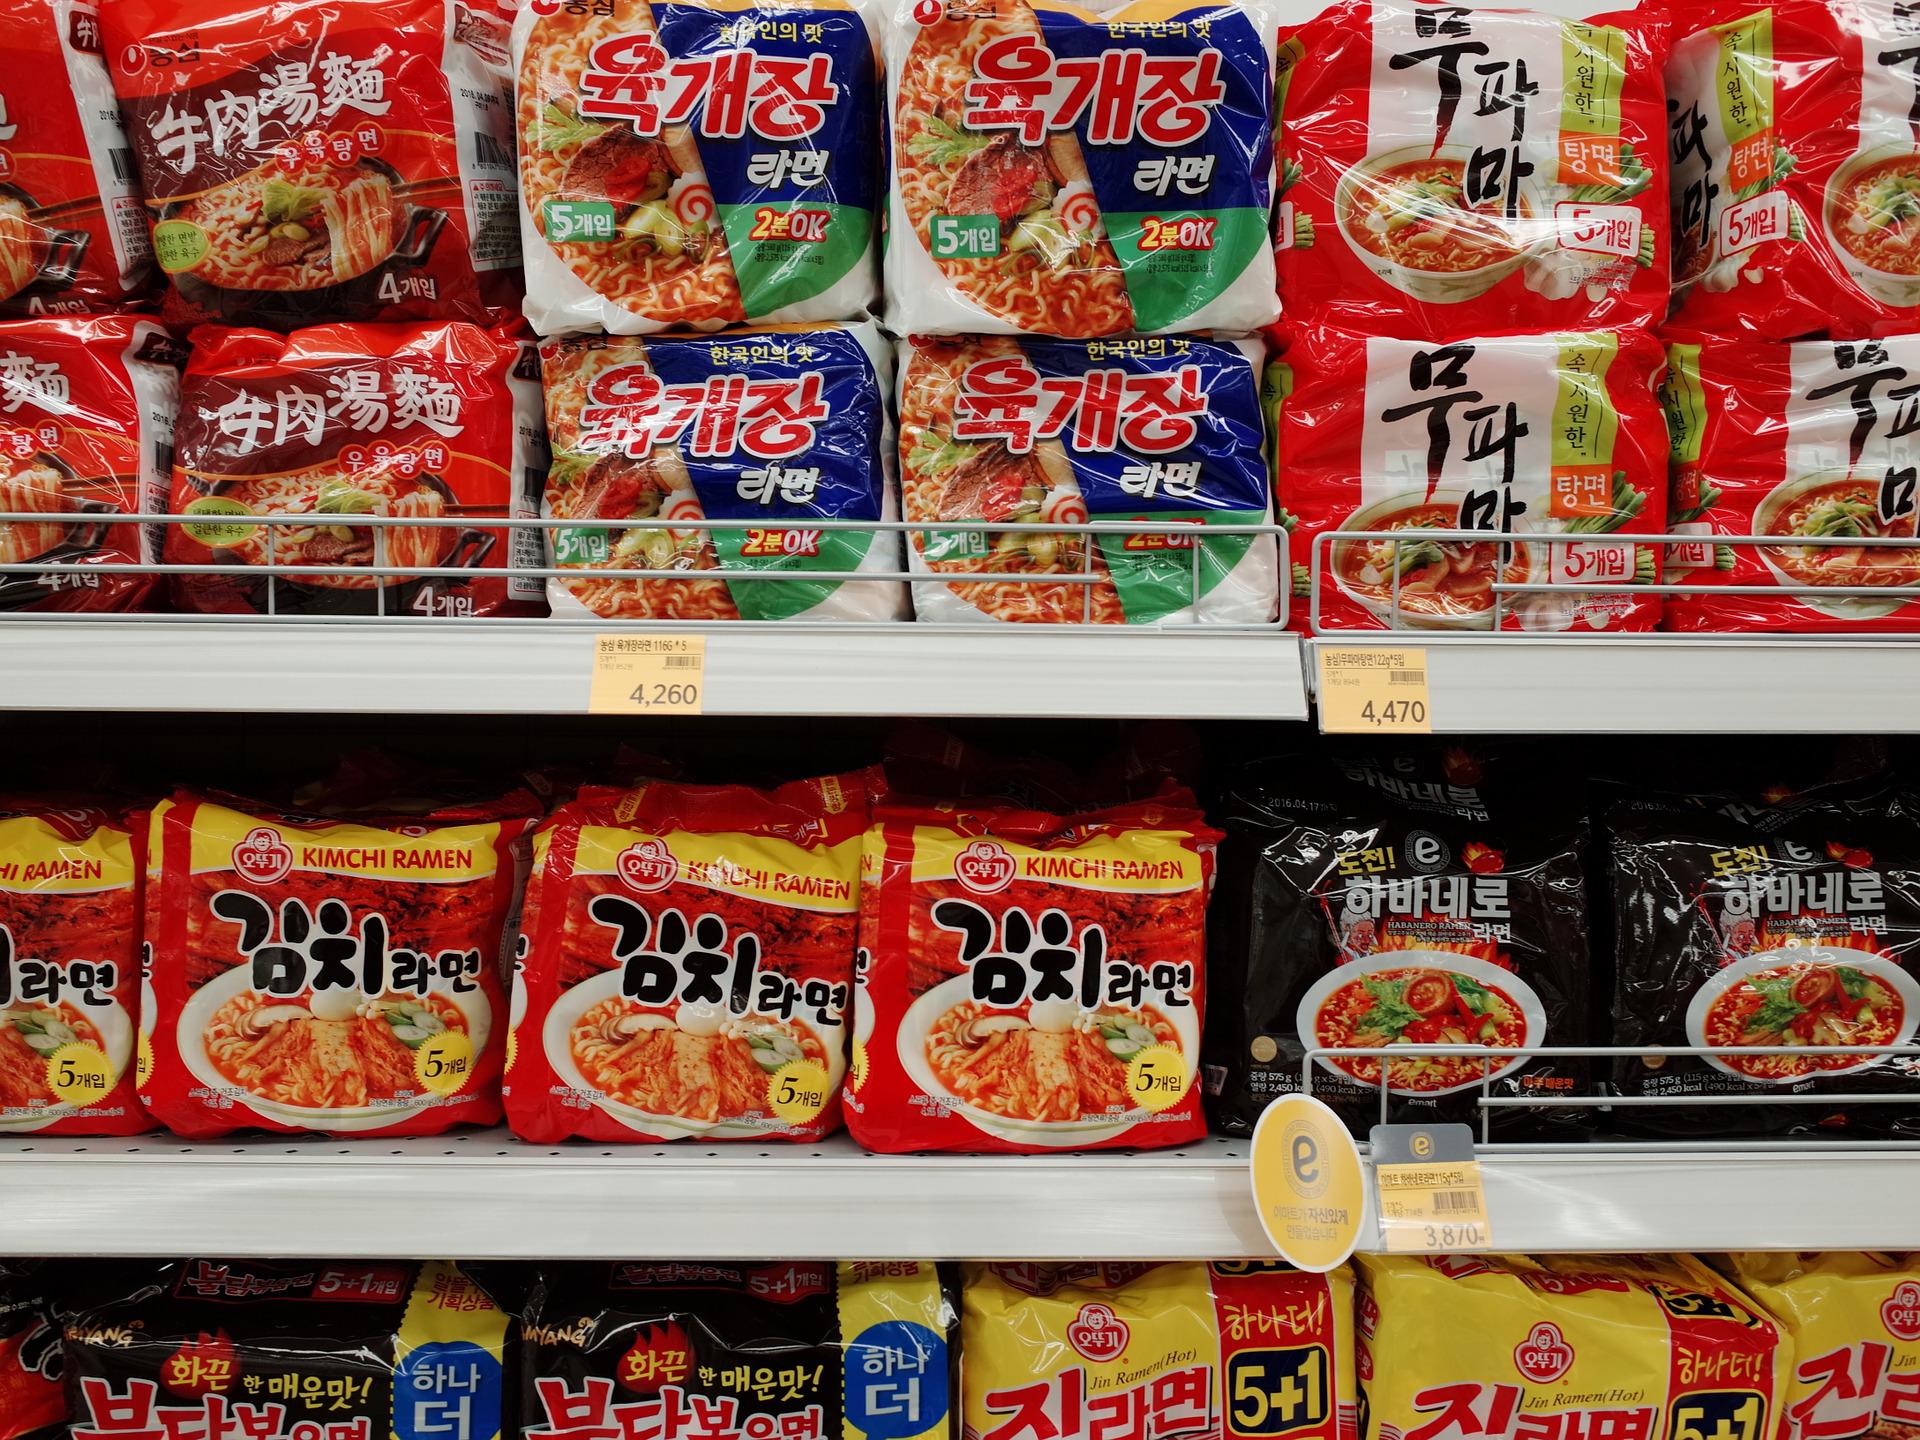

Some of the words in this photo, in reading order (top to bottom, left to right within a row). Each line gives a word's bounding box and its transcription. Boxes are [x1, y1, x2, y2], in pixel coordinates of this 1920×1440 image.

[804, 24, 824, 43] 맛
[1194, 18, 1212, 38] 맛
[579, 31, 838, 141] 육개장
[963, 32, 1226, 146] 육개장
[150, 47, 392, 175] 牛肉湯麵
[278, 126, 381, 168] 우육탕면
[1563, 142, 1615, 175] 탕면
[1733, 137, 1771, 179] 탕면
[747, 150, 830, 189] 라면
[1133, 154, 1216, 197] 라면
[1669, 99, 1718, 249] 파마
[550, 204, 611, 238] 5개입
[751, 210, 827, 240] 2분OK
[936, 219, 996, 253] 5개입
[1141, 219, 1214, 248] 2분OK
[1573, 209, 1632, 249] 5개입
[1728, 206, 1776, 246] 5개입
[378, 273, 437, 304] 4개입
[709, 345, 790, 366] 한국인의
[1086, 339, 1166, 361] 한국인의
[1171, 339, 1191, 355] 맛
[219, 366, 465, 454] 牛肉湯麵
[579, 361, 831, 459] 육개장
[953, 355, 1209, 454] 육개장
[345, 442, 444, 475] 우육탕면
[1381, 343, 1529, 563] 무파마
[736, 467, 820, 505] 라면
[1119, 461, 1202, 498] 라면
[1556, 472, 1606, 508] 탕면
[556, 529, 605, 559] 5개입
[744, 529, 818, 555] 2분OK
[926, 530, 986, 557] 5개입
[1564, 542, 1625, 577] 5개입
[412, 586, 473, 616] 4개입
[629, 684, 698, 708] 4,260
[1361, 700, 1426, 726] 4,470
[23, 860, 102, 882] RAMEN
[243, 852, 284, 869] 오뚜기
[303, 847, 386, 869] KIMCHI
[393, 849, 472, 869] RAMEN
[626, 859, 667, 880] 오뚜기
[965, 861, 1005, 878] 오뚜기
[1026, 857, 1106, 879] KIMCHI
[1113, 860, 1184, 880] RAMEN
[1337, 847, 1397, 876] 도전!
[1710, 845, 1770, 878] 도전!
[773, 873, 850, 901] RAMEN
[1346, 876, 1511, 919] 하바네로
[1723, 872, 1886, 919] 하바네로
[1388, 921, 1437, 929] HABANERO
[1472, 922, 1512, 944] 라면
[1849, 914, 1889, 936] 라면
[57, 1059, 106, 1089] 5개입
[424, 1049, 467, 1078] 5개입
[1135, 1063, 1182, 1092] 5개입
[1268, 1072, 1285, 1082] 575
[775, 1078, 823, 1108] 5개입
[1268, 1083, 1293, 1093] 2,450
[1792, 1080, 1816, 1094] emart
[1408, 1098, 1437, 1109] emart
[1308, 1207, 1349, 1225] 자신있게
[749, 1267, 824, 1294] 5+1개입
[427, 1290, 495, 1312] 기획상품
[1079, 1332, 1119, 1348] 오뚜기
[1523, 1352, 1563, 1370] 오뚜기
[1894, 1353, 1916, 1368] Jin
[168, 1354, 232, 1392] 화끈
[242, 1373, 265, 1396] 한
[267, 1371, 374, 1411] 매운맛!
[625, 1351, 688, 1382] 화끈
[697, 1367, 718, 1388] 한
[720, 1365, 824, 1402] 매운맛!
[1090, 1375, 1112, 1391] Jin
[1232, 1350, 1324, 1427] 5+1
[414, 1398, 472, 1434] 더
[865, 1379, 920, 1423] 더
[1524, 1393, 1549, 1409] Jin
